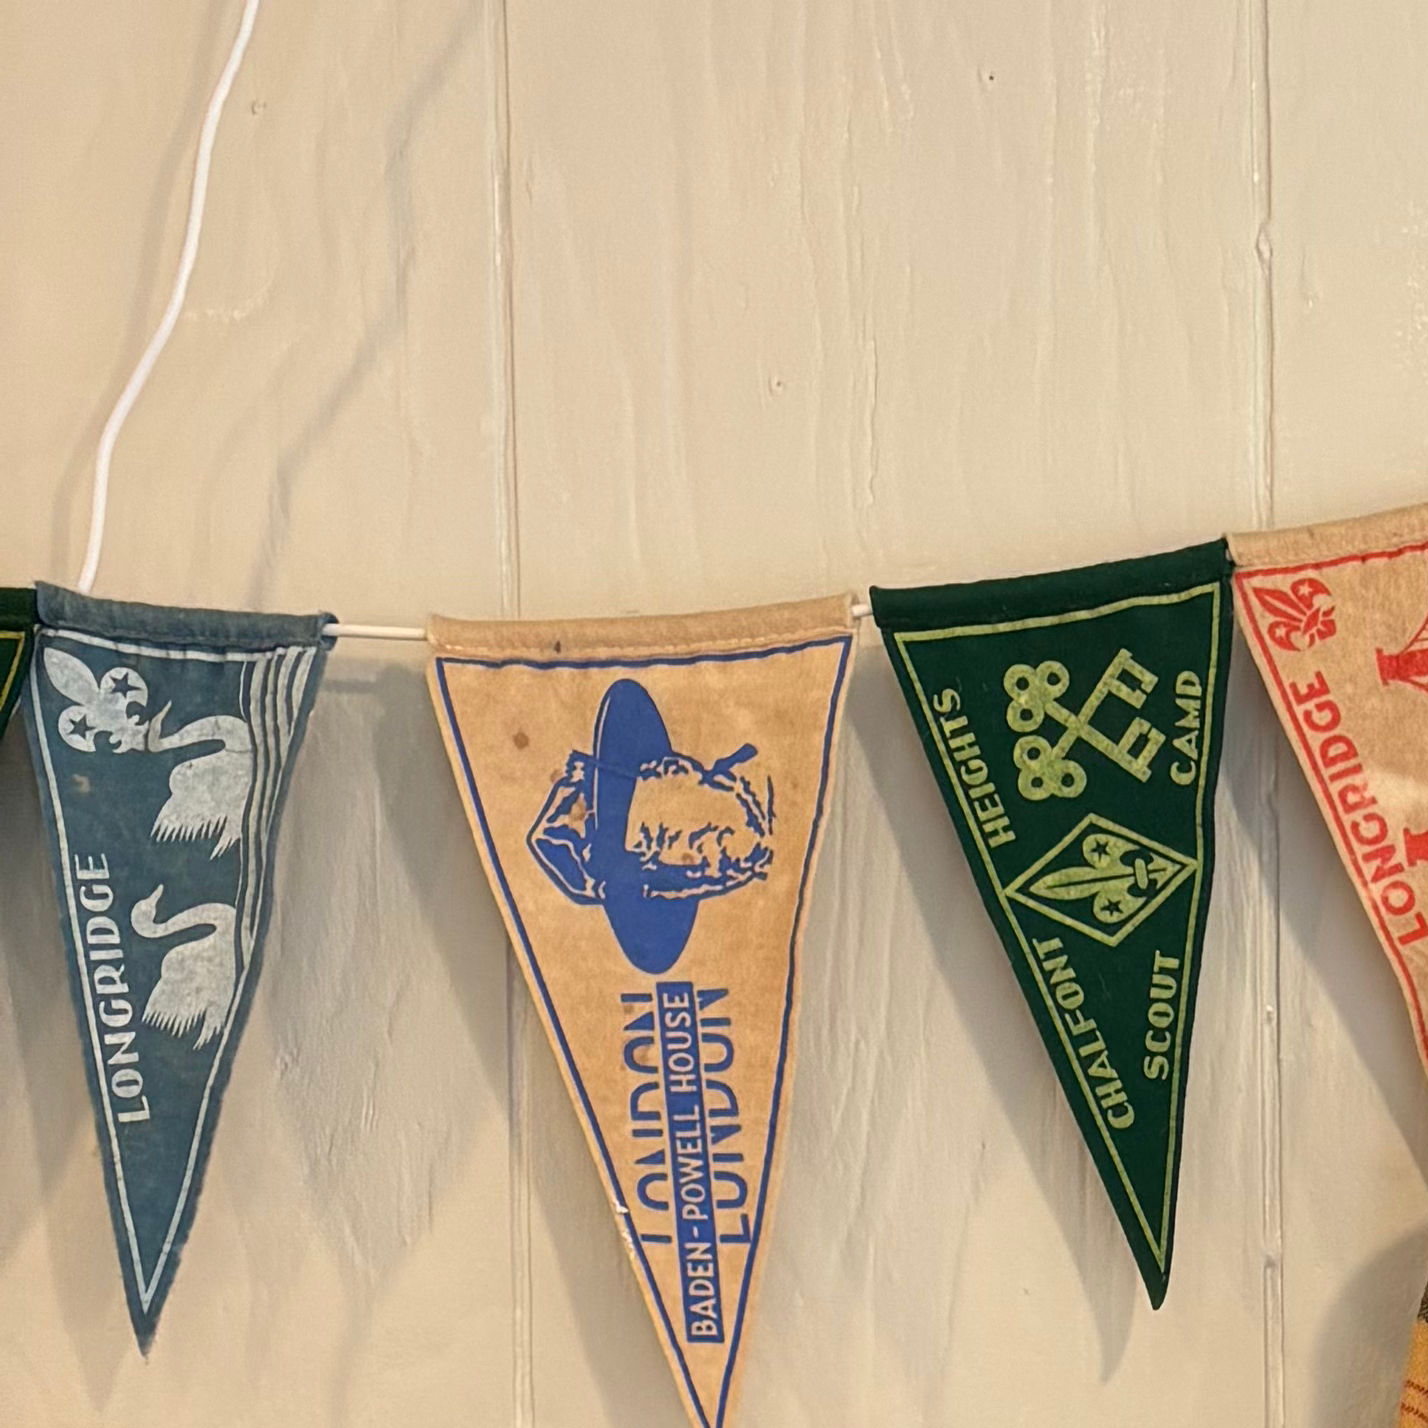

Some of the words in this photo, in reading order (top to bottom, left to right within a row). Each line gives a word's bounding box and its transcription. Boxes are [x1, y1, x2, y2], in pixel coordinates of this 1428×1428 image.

[933, 688, 1015, 850] HEIGHTS
[1144, 950, 1180, 1081] SCOUT
[1169, 669, 1202, 786] CAMP
[72, 852, 151, 1124] LONGRIDGE
[662, 991, 698, 1093] HOUSE
[1032, 936, 1134, 1130] CHALFONT
